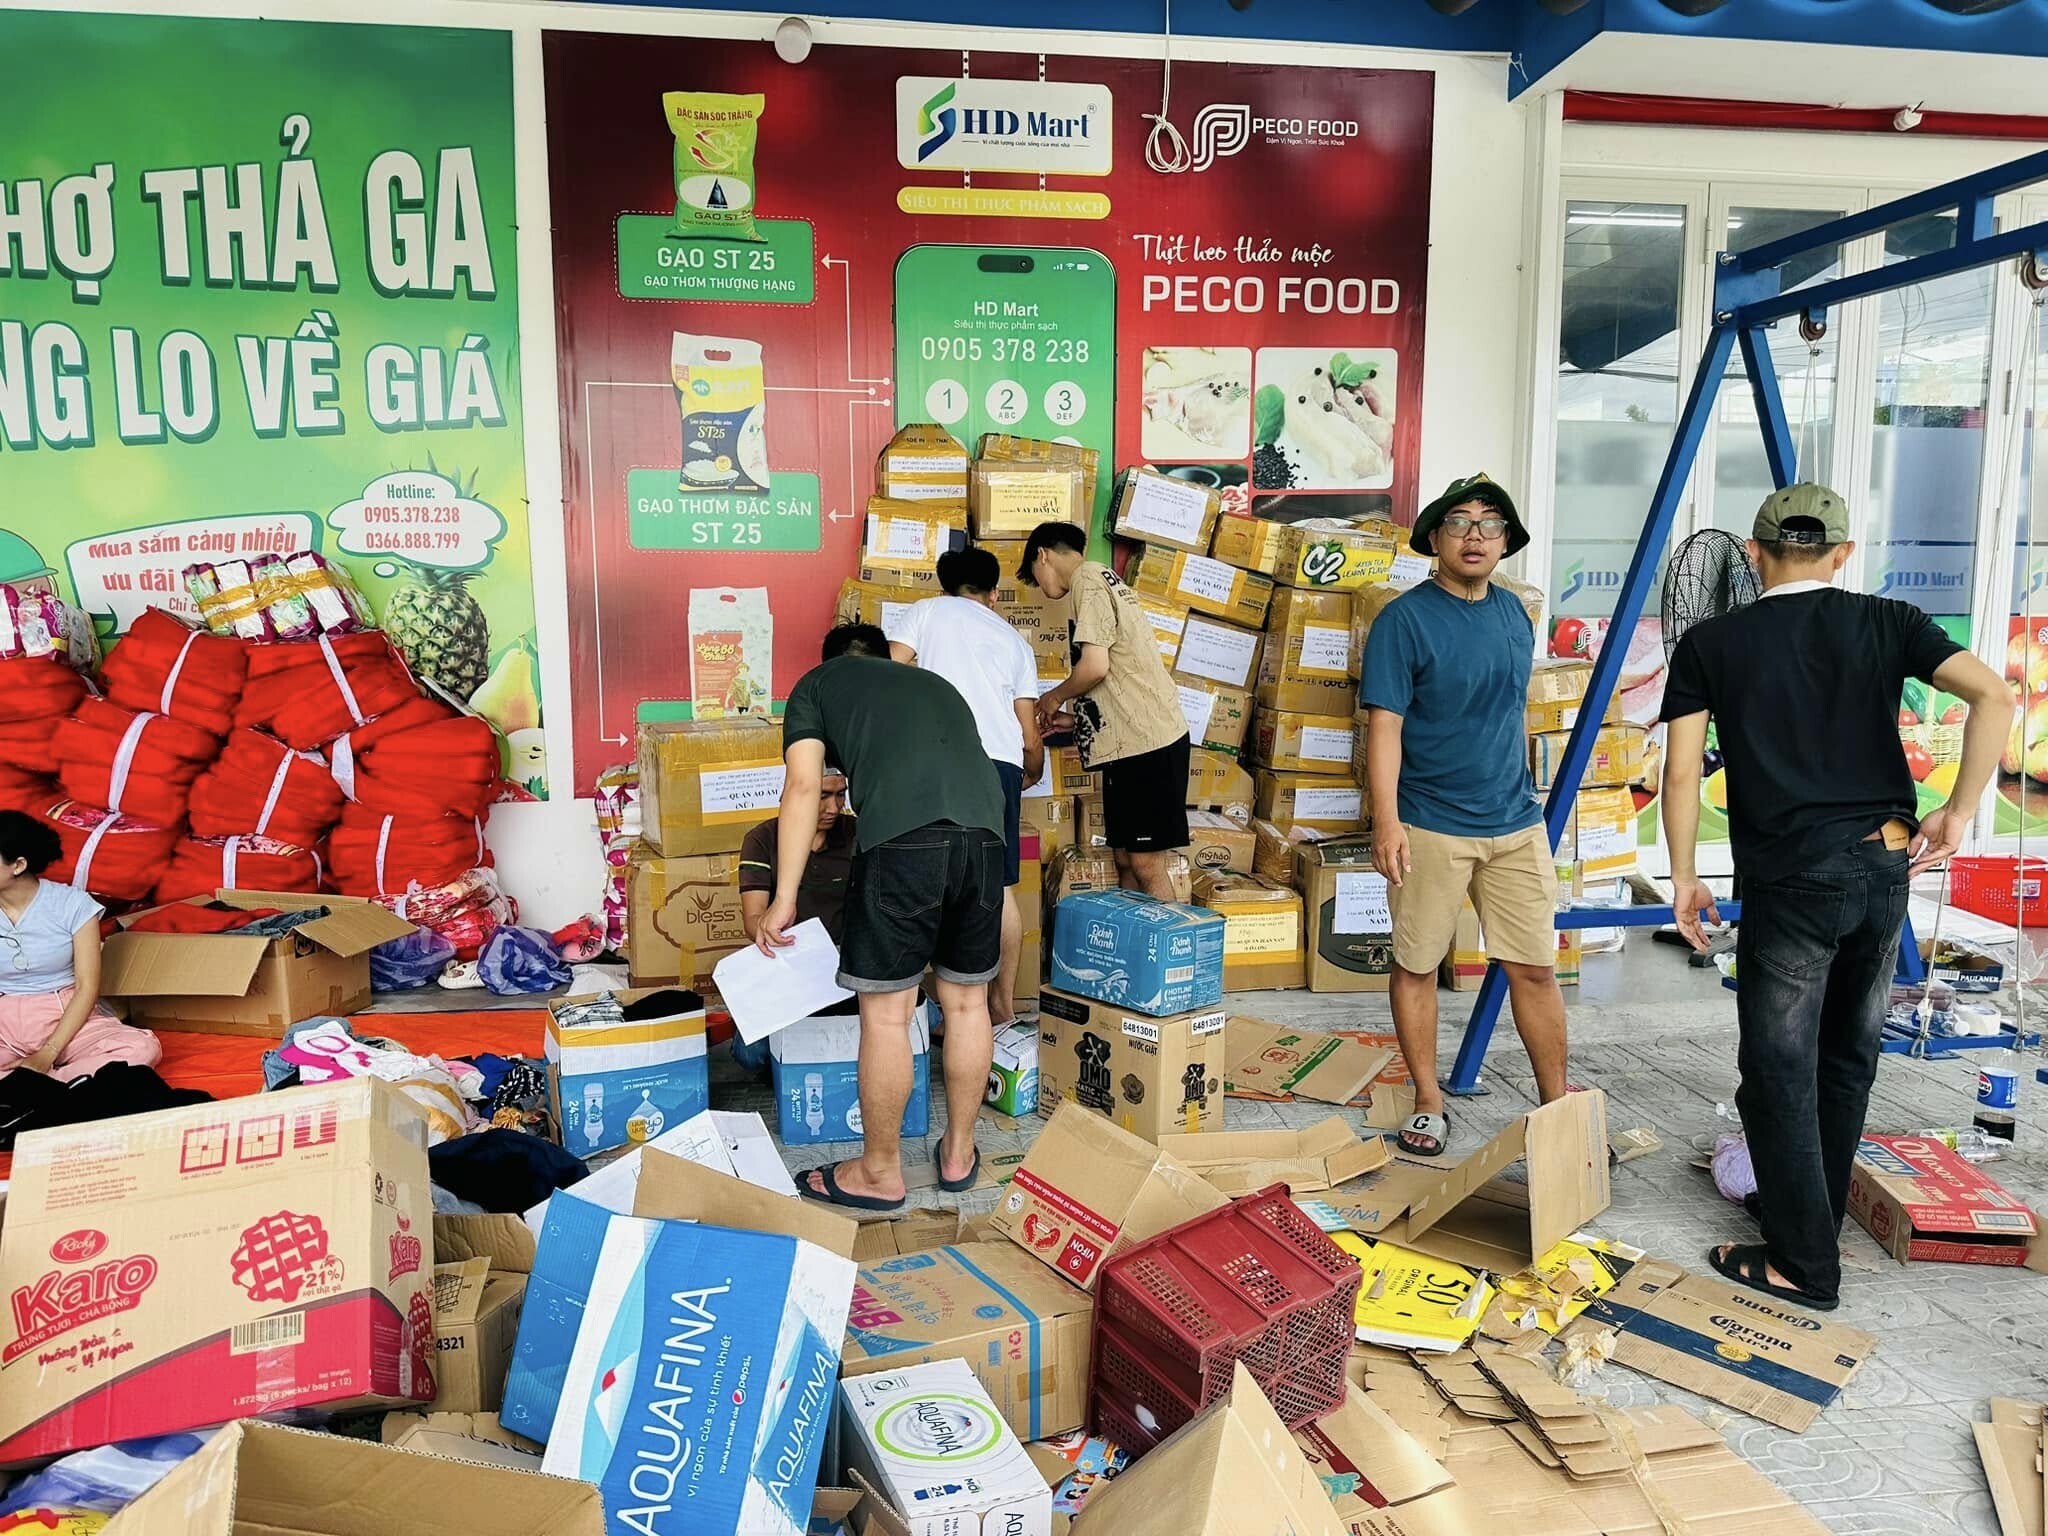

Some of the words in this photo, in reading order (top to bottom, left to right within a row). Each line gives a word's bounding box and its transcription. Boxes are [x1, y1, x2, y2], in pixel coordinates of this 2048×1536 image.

[961, 109, 1019, 135] HD
[1027, 111, 1091, 138] Mart
[1253, 118, 1302, 135] PECO
[1308, 119, 1358, 137] FOOD
[142, 114, 339, 292] THẢ
[364, 146, 497, 300] GA
[904, 191, 937, 208] SIÊU
[657, 248, 704, 273] GẠO
[713, 249, 741, 270] ST
[748, 250, 775, 271] 25
[1133, 234, 1188, 265] Thịt
[1194, 236, 1227, 261] heo
[1234, 236, 1283, 263] thảo
[644, 276, 668, 291] GẠO
[671, 275, 706, 289] THƠM
[709, 276, 759, 293] THƯỢNG
[762, 279, 796, 293] HẠNG
[1142, 275, 1264, 313] PECO
[1279, 277, 1399, 315] FOOD
[973, 301, 998, 317] HD
[1003, 302, 1039, 317] Mart
[954, 319, 973, 329] Siêu
[974, 319, 987, 331] thị
[989, 320, 1009, 331] thực
[1011, 320, 1035, 332] phẩm
[1038, 321, 1058, 331] sạch
[921, 337, 982, 361] 0905
[991, 338, 1036, 361] 378
[1045, 340, 1089, 362] 238
[111, 329, 218, 444] LO
[236, 311, 344, 438] VỀ
[364, 335, 506, 432] GIÁ
[943, 389, 951, 409] 1
[1000, 389, 1014, 410] 2
[1058, 390, 1072, 411] 3
[1056, 412, 1073, 420] DEF
[697, 425, 725, 439] ST25
[386, 484, 436, 500] Hotline:
[364, 507, 460, 524] 0905.378.238
[638, 499, 673, 517] GẠO
[679, 497, 729, 513] THƠM
[735, 497, 770, 518] ĐẶC
[776, 496, 812, 516] SẢN
[88, 541, 132, 559] Mua
[139, 528, 180, 554] sắm
[187, 529, 235, 554] càng
[242, 522, 297, 553] nhiều
[365, 532, 460, 549] 0366.888.799
[692, 522, 723, 543] ST
[732, 523, 762, 544] 25
[1302, 545, 1346, 585] C2
[103, 572, 132, 592] ưu
[139, 568, 175, 592] đãi
[1587, 571, 1619, 586] HD
[1897, 572, 1927, 586] HD
[1931, 572, 1964, 587] Mart
[169, 597, 188, 612] Chỉ
[1007, 615, 1040, 627] Downy
[687, 909, 735, 924] bless
[1148, 947, 1157, 963] 24
[1960, 973, 2000, 983] PAULANER
[1122, 1021, 1157, 1039] 64813001
[1192, 1016, 1225, 1032] 64813001
[1079, 1061, 1111, 1091] OMO
[791, 1088, 800, 1102] 24
[1185, 1083, 1206, 1101] OMO
[1858, 1142, 1924, 1176] MILK
[388, 1231, 422, 1266] Karo
[1071, 1238, 1096, 1260] VIFON
[305, 1269, 340, 1289] 21%
[1396, 1267, 1422, 1296] ORIGINAL
[11, 1255, 158, 1337] Karo
[1732, 1294, 1822, 1331] Corona
[49, 1318, 72, 1335] TƯƠI
[1709, 1315, 1793, 1351] Corona
[38, 1345, 77, 1367] Vuông
[80, 1334, 106, 1351] Tròn
[718, 1334, 732, 1367] khiết
[1726, 1330, 1769, 1351] Extra
[82, 1352, 94, 1368] Vị
[98, 1342, 134, 1362] Ngon
[710, 1368, 722, 1394] tinh
[740, 1355, 753, 1389] pepsi
[312, 1382, 329, 1394] bag
[339, 1376, 352, 1387] 12)
[616, 1278, 732, 1536] AQUAFINA
[706, 1397, 717, 1414] sự
[699, 1416, 713, 1442] của
[767, 1352, 835, 1508] AQUAFINA
[911, 1400, 967, 1458] AQUAFINA
[692, 1445, 707, 1479] ngon
[930, 1486, 944, 1499] 24
[963, 1477, 982, 1495] MỚI
